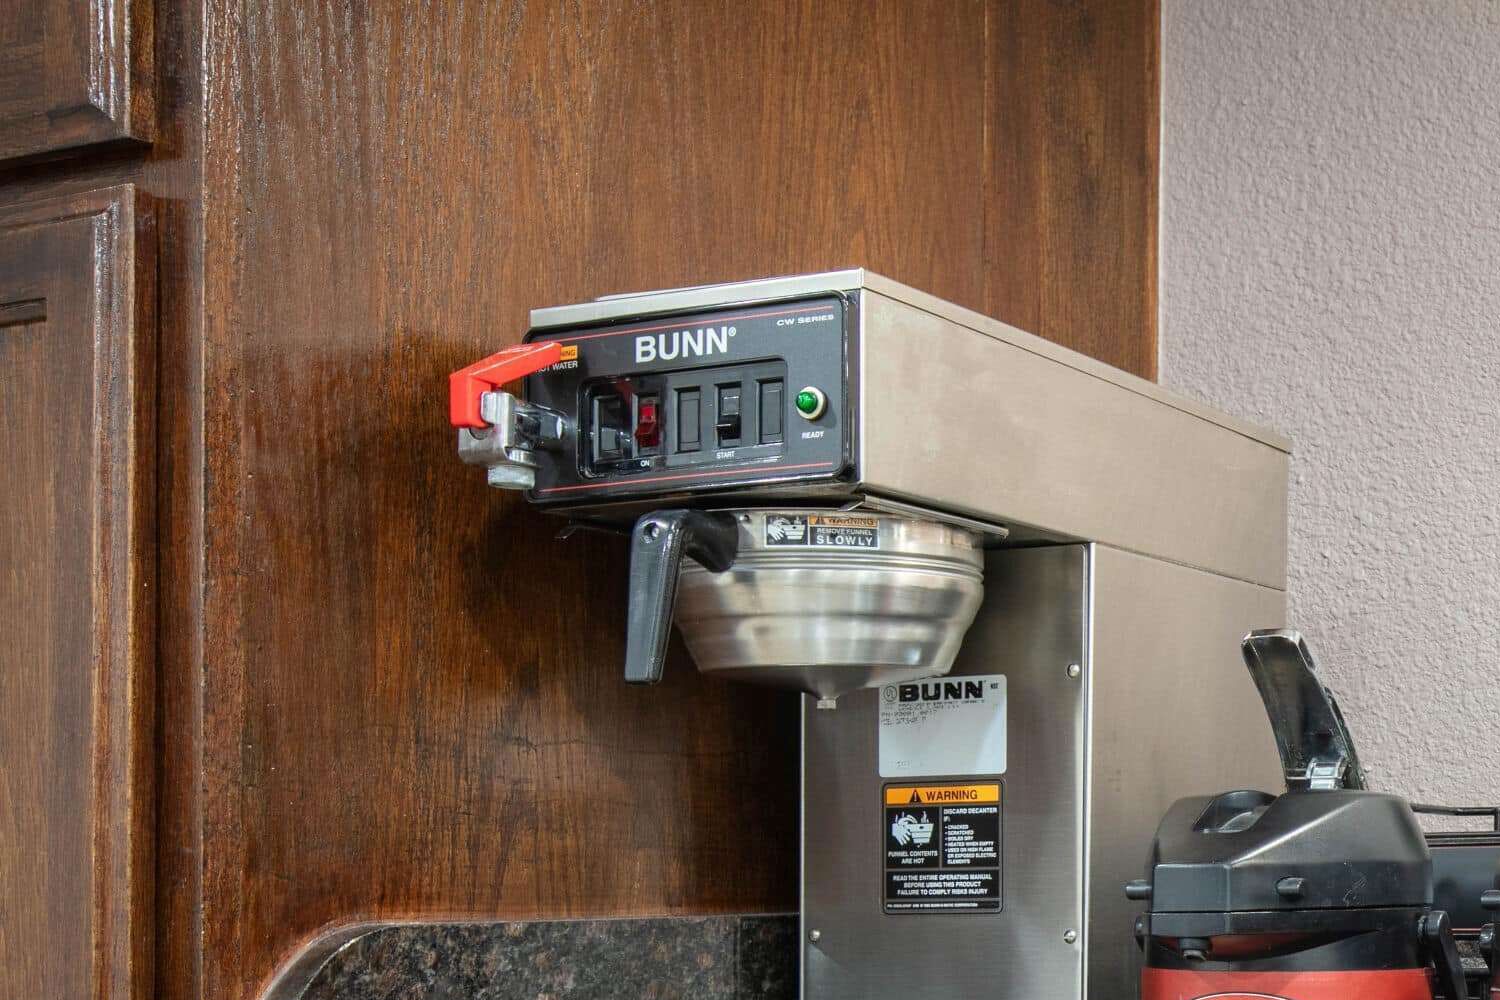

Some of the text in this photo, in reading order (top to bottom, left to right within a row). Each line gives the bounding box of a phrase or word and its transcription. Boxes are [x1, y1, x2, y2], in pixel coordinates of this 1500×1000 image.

[552, 360, 578, 370] WATER
[802, 431, 825, 439] READY
[716, 451, 735, 460] START
[640, 459, 650, 467] ON
[816, 535, 873, 546] SLOWLY
[926, 789, 978, 801] WARNING
